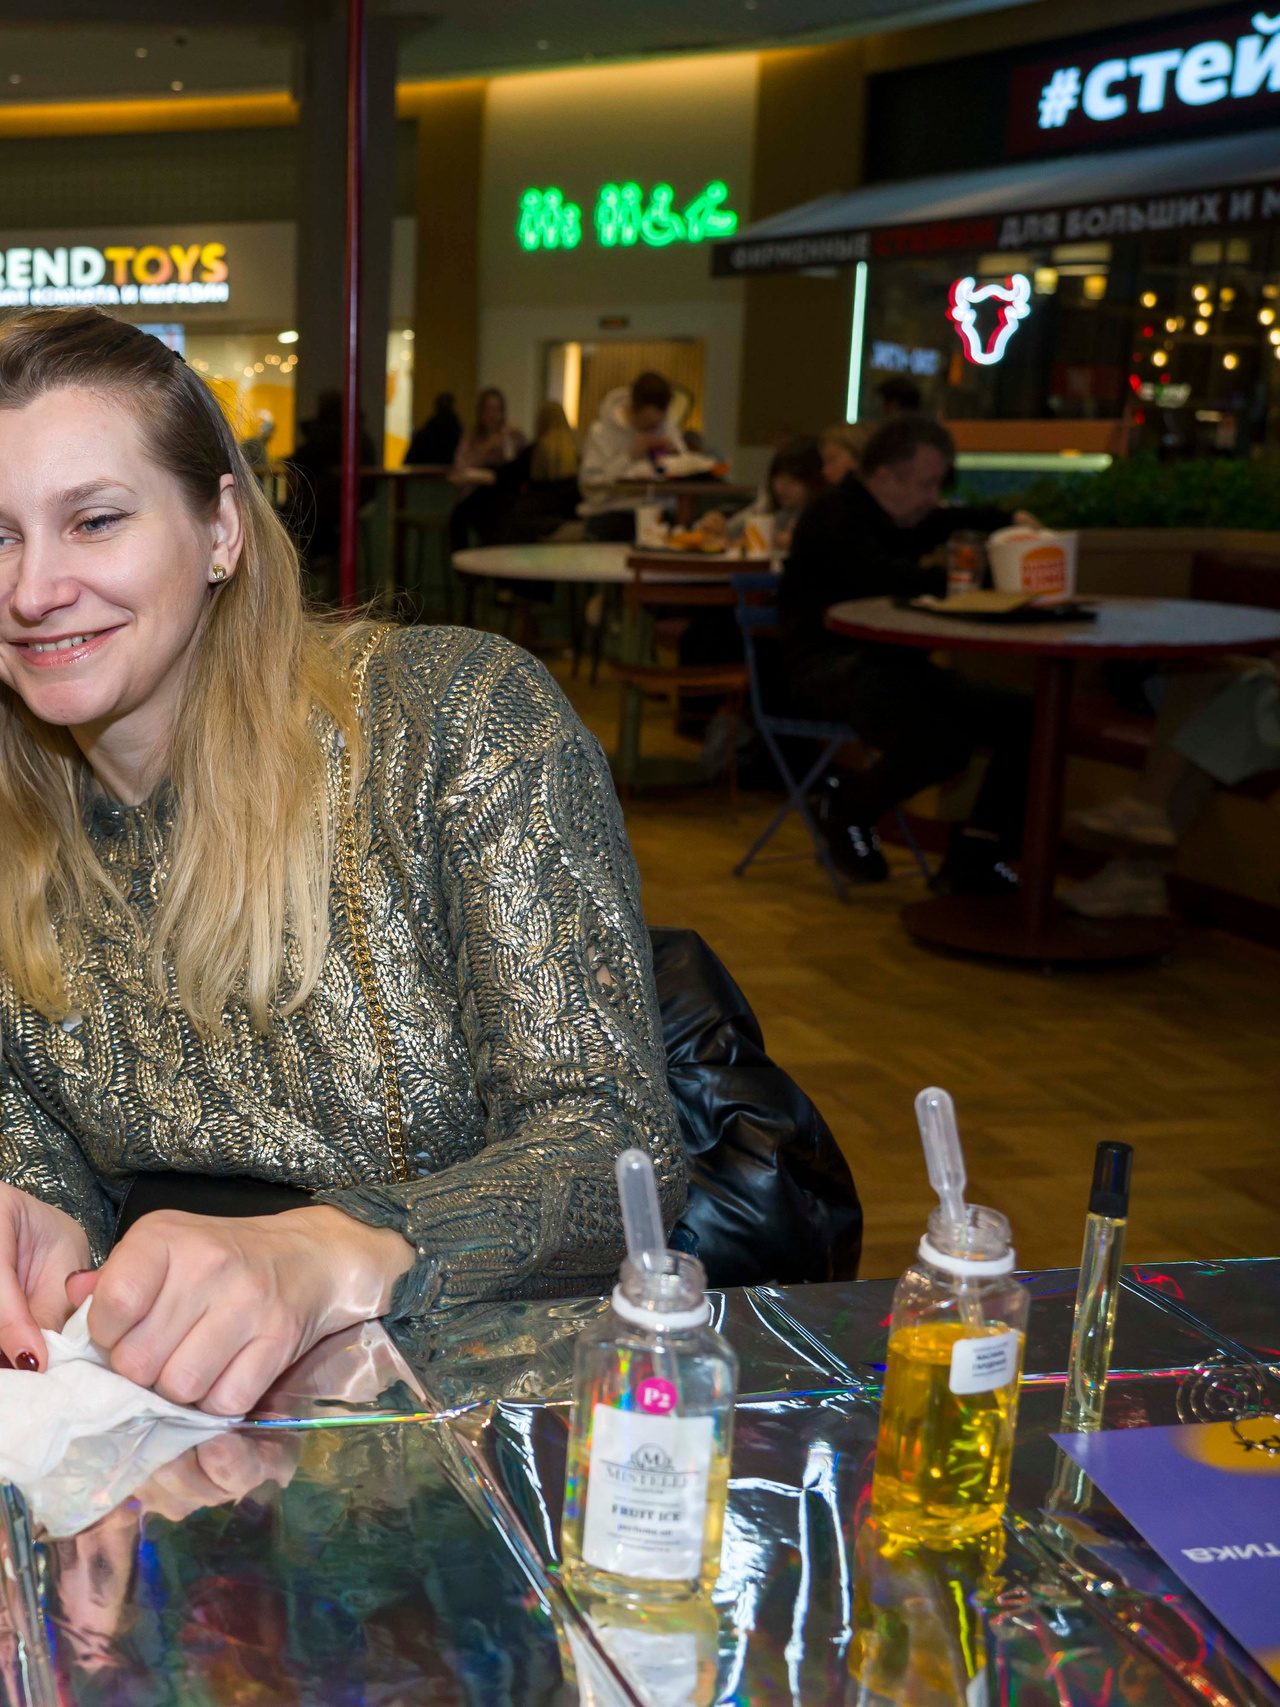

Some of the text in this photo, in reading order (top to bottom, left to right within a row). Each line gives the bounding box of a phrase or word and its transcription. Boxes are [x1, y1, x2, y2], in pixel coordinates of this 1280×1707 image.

[998, 212, 1061, 248] ДЛЯ
[1064, 196, 1221, 239] БОЛЬШИХ
[1228, 190, 1255, 222] И
[643, 1387, 672, 1408] P2
[612, 1503, 682, 1522] FRUIT ICE
